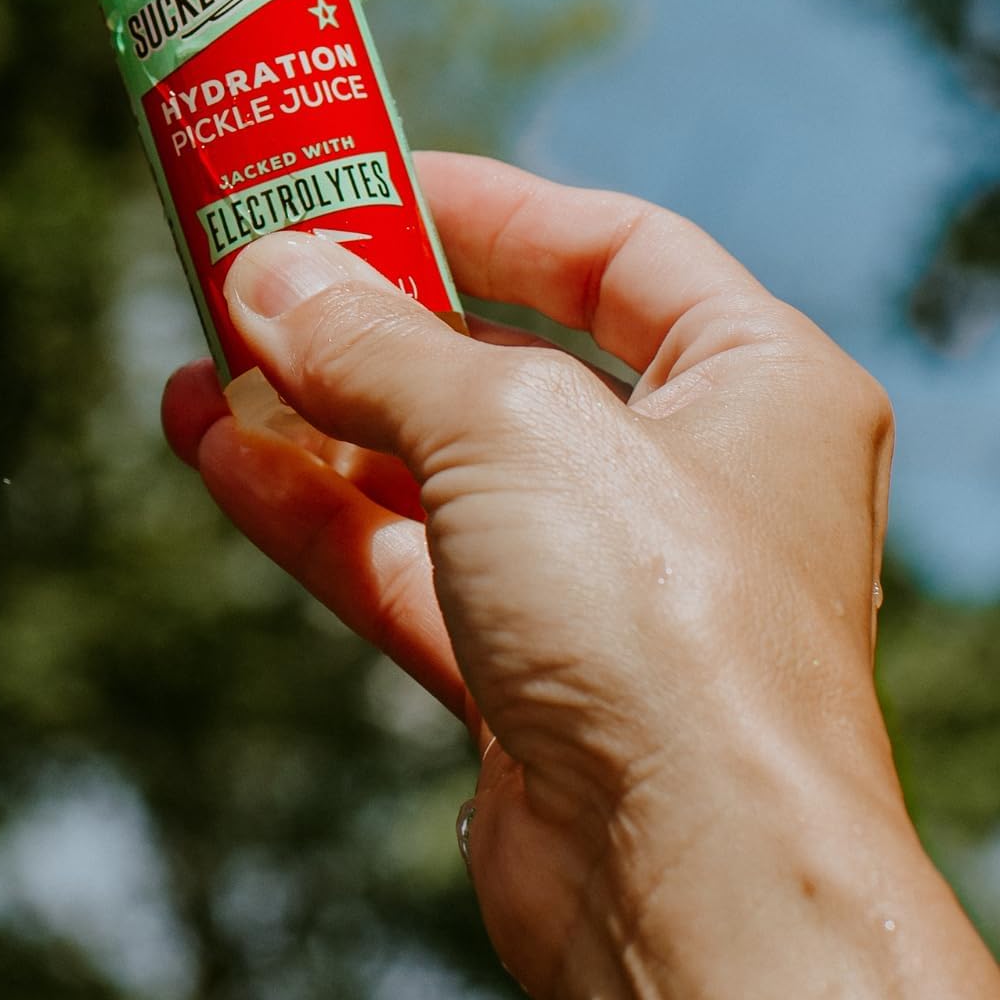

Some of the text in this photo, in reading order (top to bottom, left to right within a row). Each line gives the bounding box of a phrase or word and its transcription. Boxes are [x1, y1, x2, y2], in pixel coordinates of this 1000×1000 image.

[161, 42, 358, 126] HYDRATION
[170, 74, 369, 157] PICKLE JUICE
[218, 135, 356, 191] JACKED WITH
[205, 160, 391, 253] ELECTROLYTES
